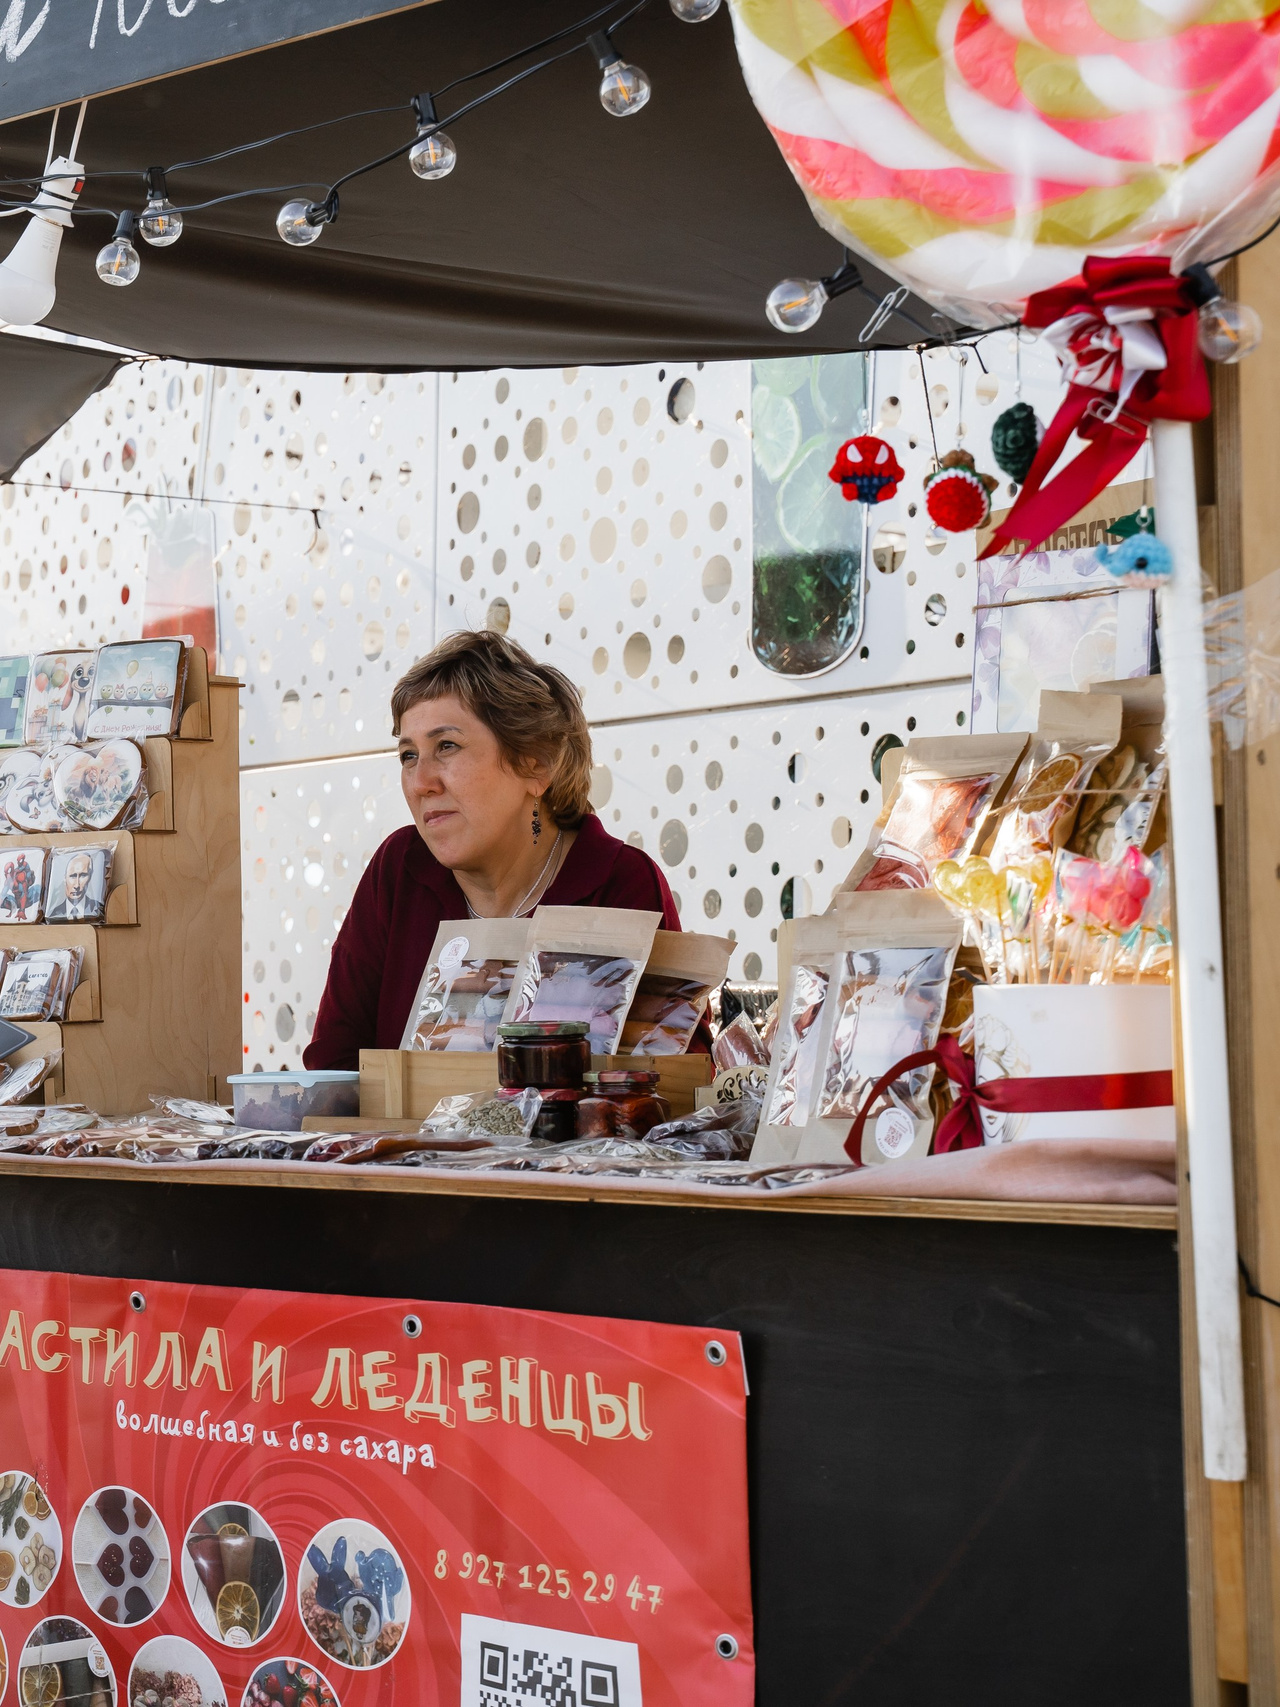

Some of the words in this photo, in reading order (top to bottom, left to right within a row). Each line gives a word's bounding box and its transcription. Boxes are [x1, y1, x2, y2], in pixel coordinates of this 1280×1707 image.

[251, 1340, 288, 1405] И
[310, 1347, 653, 1446] ЛЕДЕНЦЫ
[115, 1399, 257, 1446] волшебная
[262, 1430, 283, 1448] и
[289, 1420, 331, 1453] без
[340, 1435, 438, 1475] сахара
[433, 1549, 449, 1581] 8
[458, 1551, 508, 1589] 927
[518, 1563, 573, 1600] 125
[583, 1570, 618, 1604] 29
[625, 1574, 665, 1615] 47
